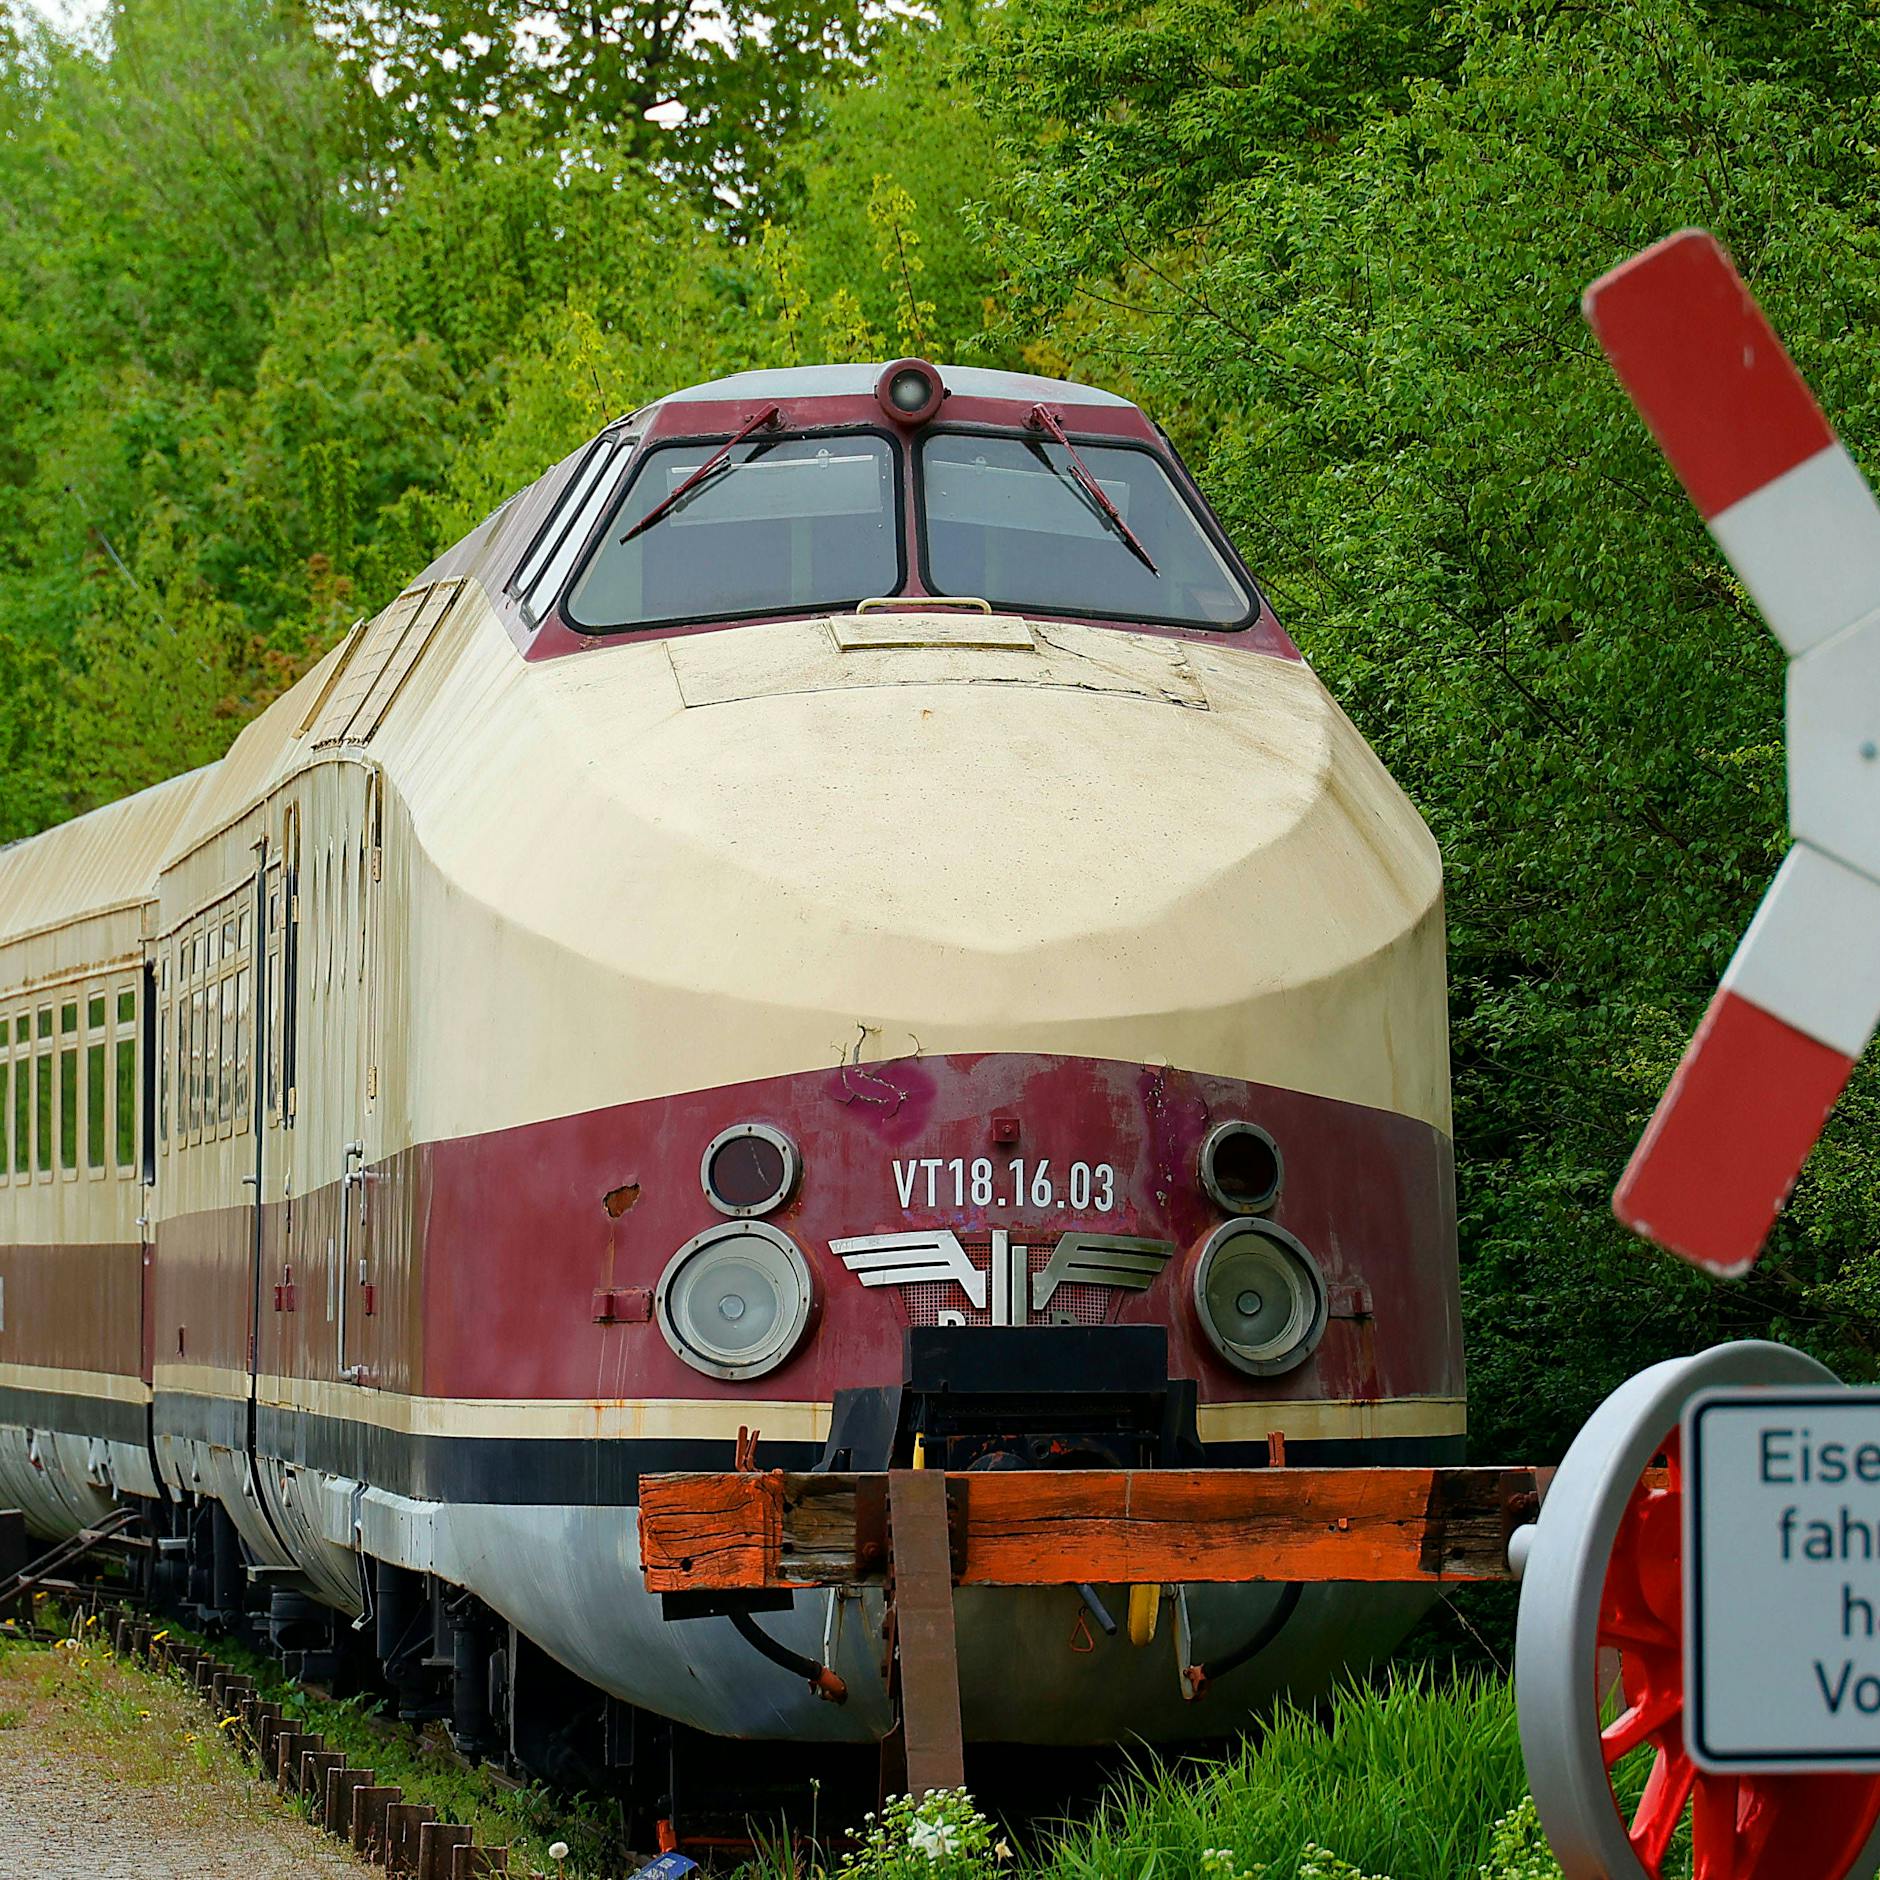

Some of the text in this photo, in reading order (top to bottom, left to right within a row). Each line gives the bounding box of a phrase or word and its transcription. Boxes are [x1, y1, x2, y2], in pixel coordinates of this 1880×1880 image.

[892, 1157, 1115, 1212] VT18.16.03
[1761, 1429, 1880, 1483] Eise
[1781, 1505, 1880, 1560] fah
[1842, 1583, 1880, 1637] h
